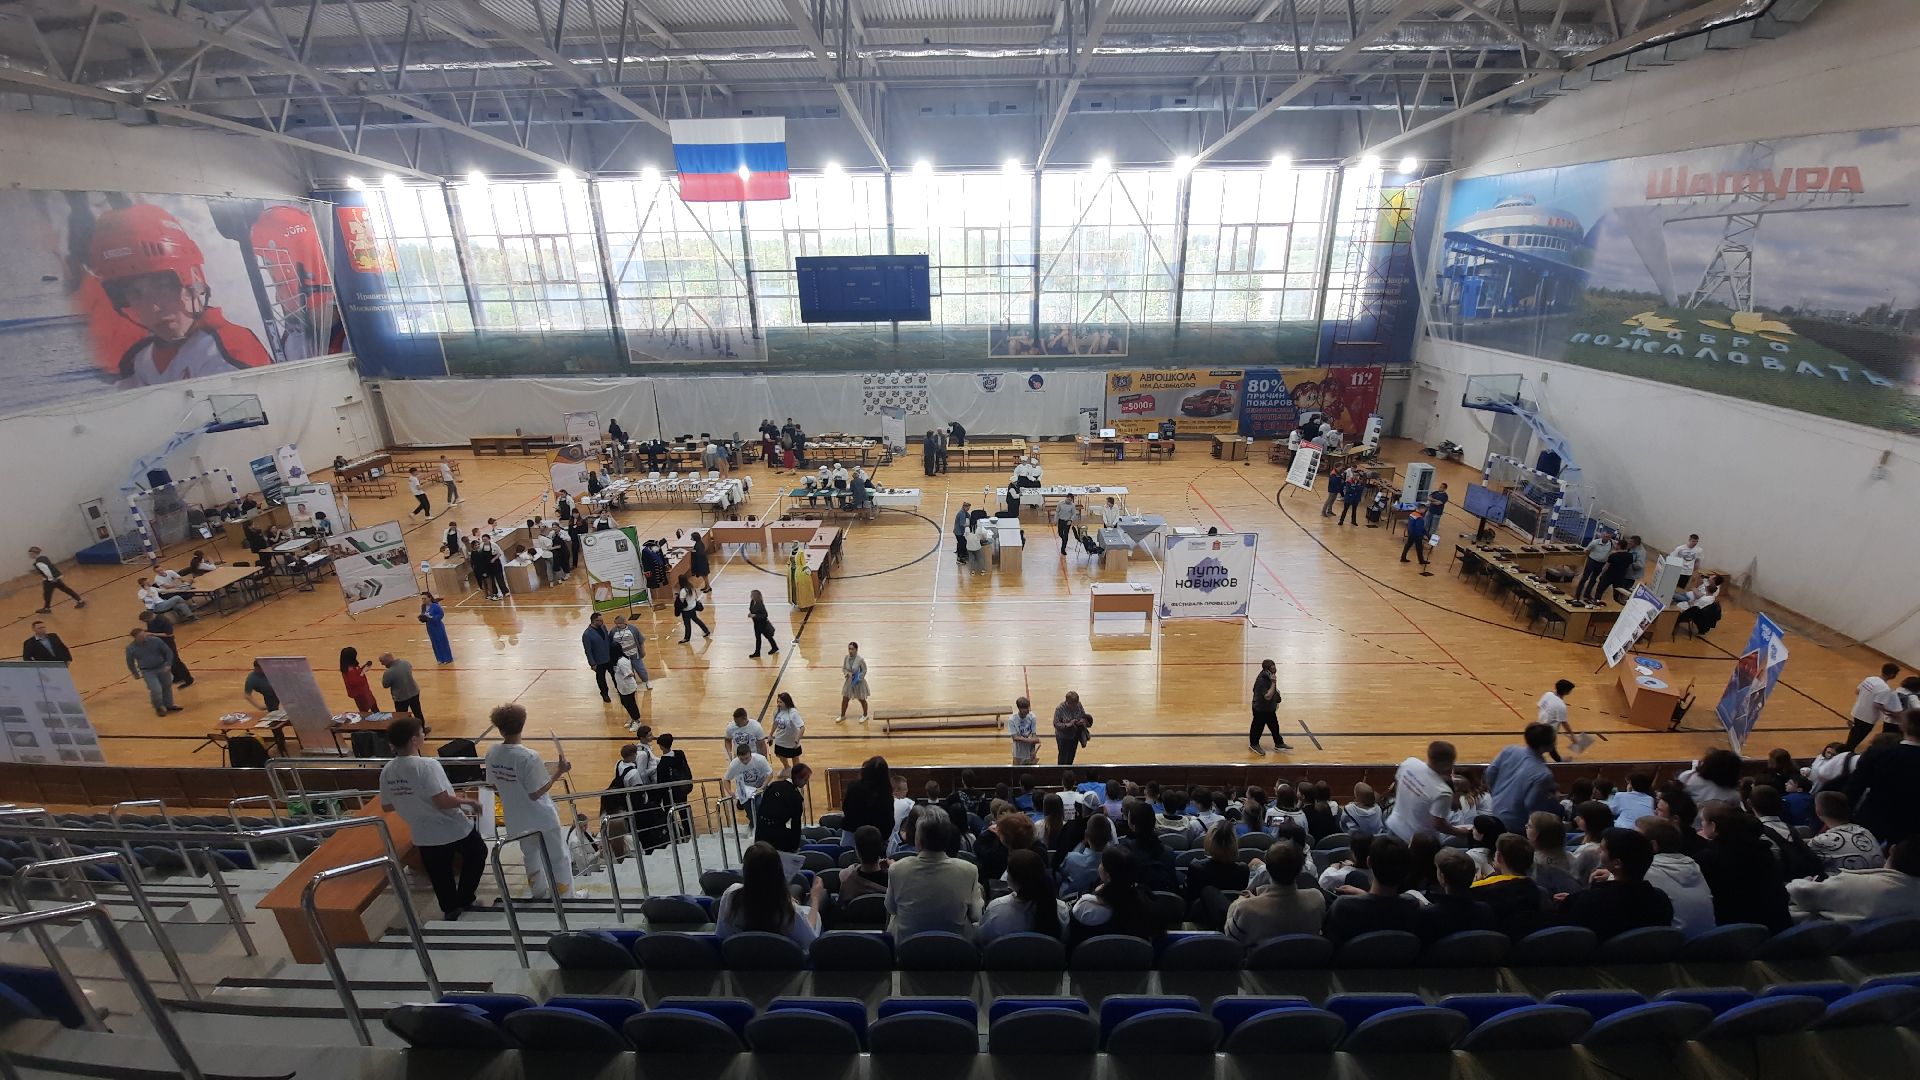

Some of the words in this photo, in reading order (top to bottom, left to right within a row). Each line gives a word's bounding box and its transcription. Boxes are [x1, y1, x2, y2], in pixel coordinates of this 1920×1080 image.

[1629, 326, 1790, 352] ДОБРО
[1569, 332, 1894, 388] ПОЖАЛОВАТЬ
[1140, 373, 1197, 382] АВТОШКОЛА
[1247, 379, 1286, 393] 80%
